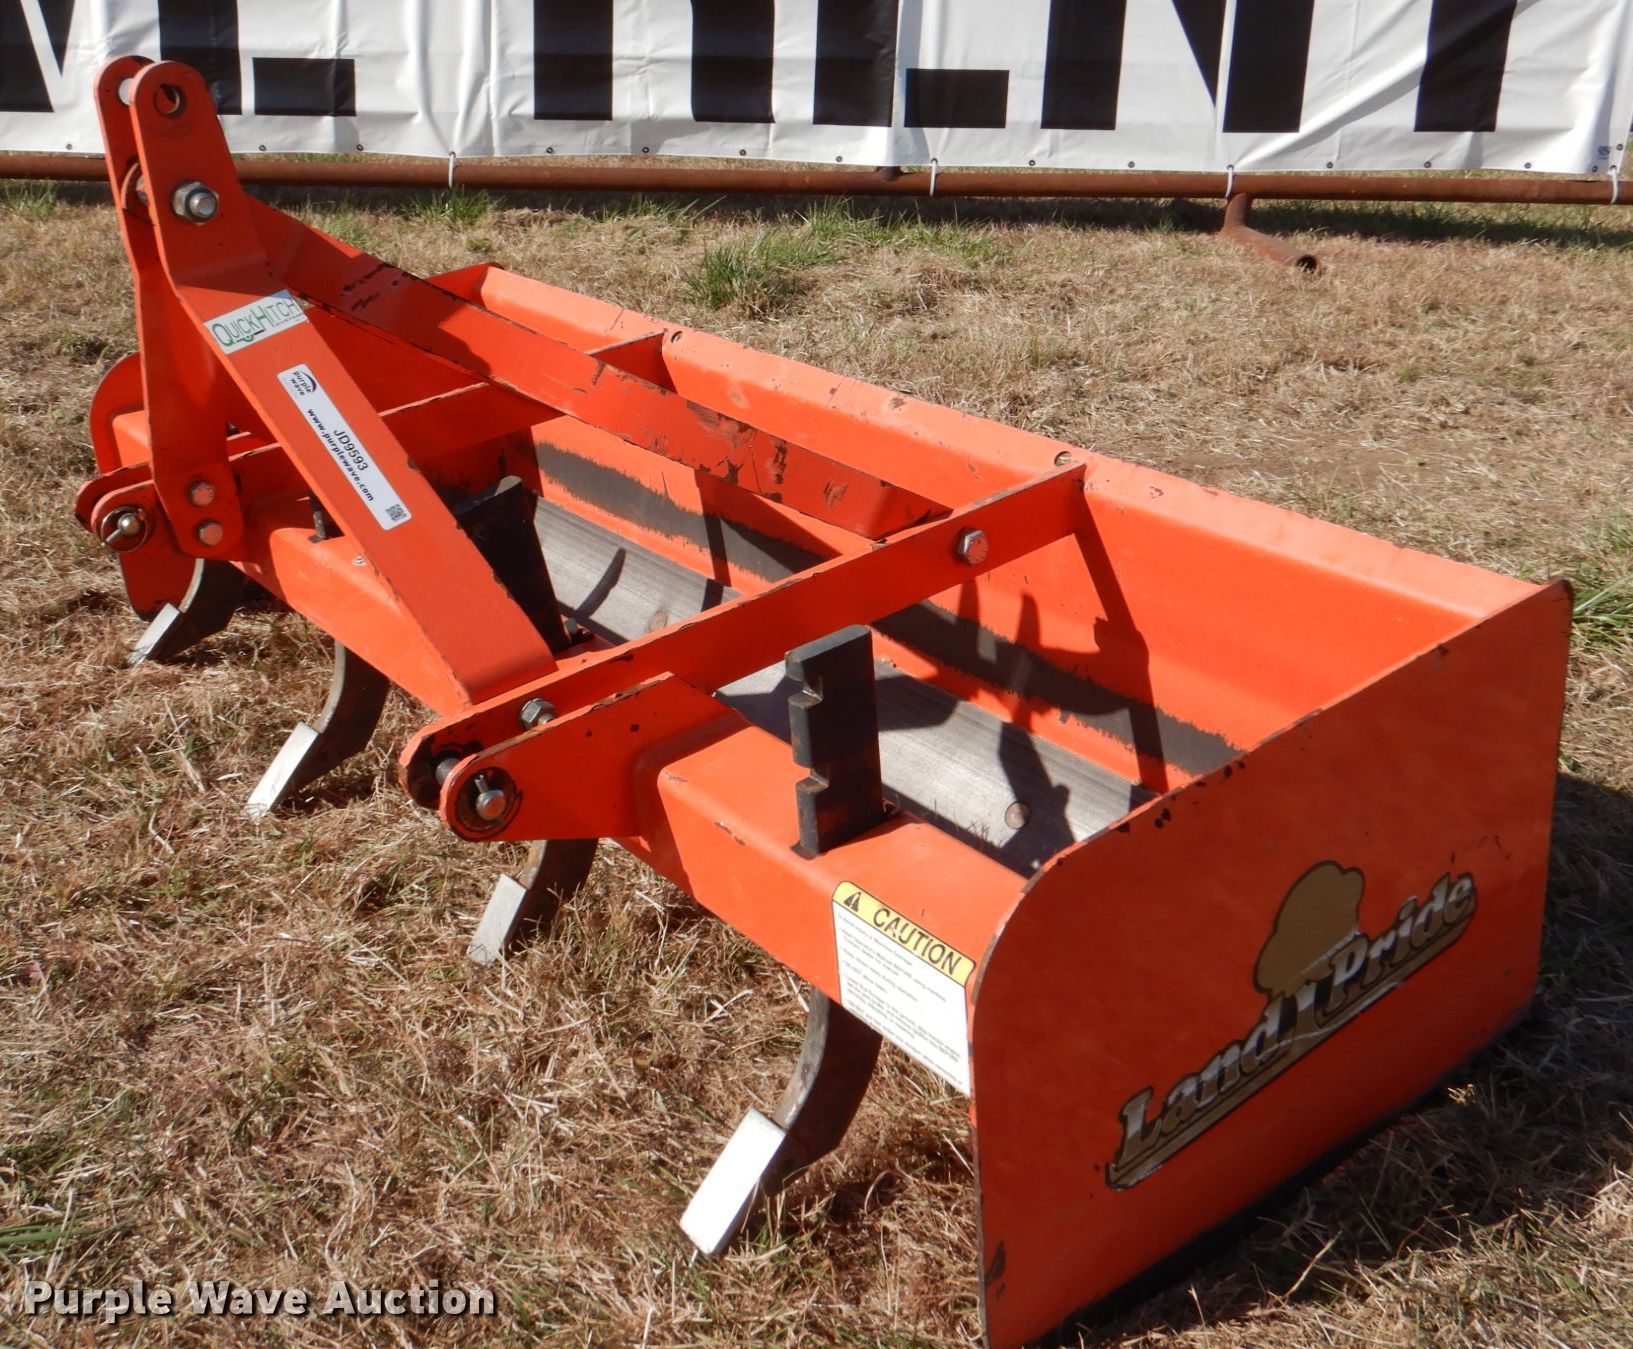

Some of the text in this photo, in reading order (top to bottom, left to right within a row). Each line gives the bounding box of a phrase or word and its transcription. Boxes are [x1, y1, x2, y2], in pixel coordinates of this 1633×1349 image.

[290, 378, 305, 396] wave
[293, 371, 312, 393] purple
[307, 408, 375, 502] www.purplewave.com
[333, 429, 369, 471] JD9593
[873, 908, 963, 976] CAUTION
[1113, 994, 1290, 1171] Land
[1320, 871, 1478, 1018] Pride
